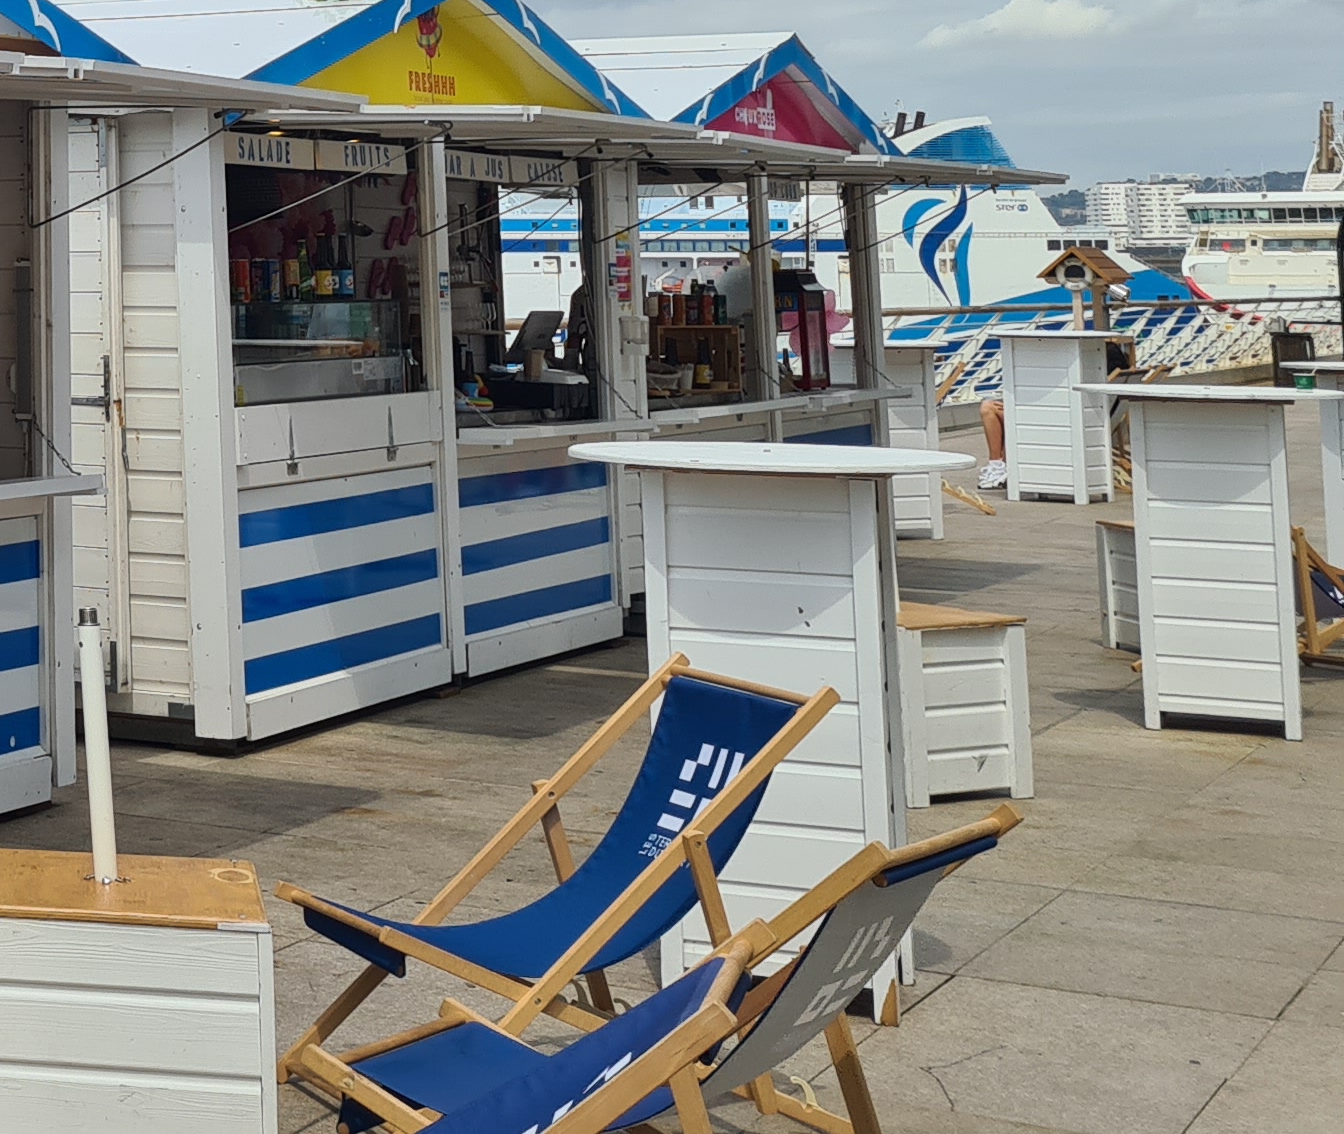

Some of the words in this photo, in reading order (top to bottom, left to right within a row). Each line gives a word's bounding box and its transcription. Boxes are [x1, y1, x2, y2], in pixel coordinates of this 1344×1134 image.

[408, 70, 455, 97] FRESHHH
[238, 137, 291, 164] SALADE
[344, 146, 390, 167] FRUITS
[485, 157, 503, 179] JUS
[527, 163, 563, 183] CAISSE
